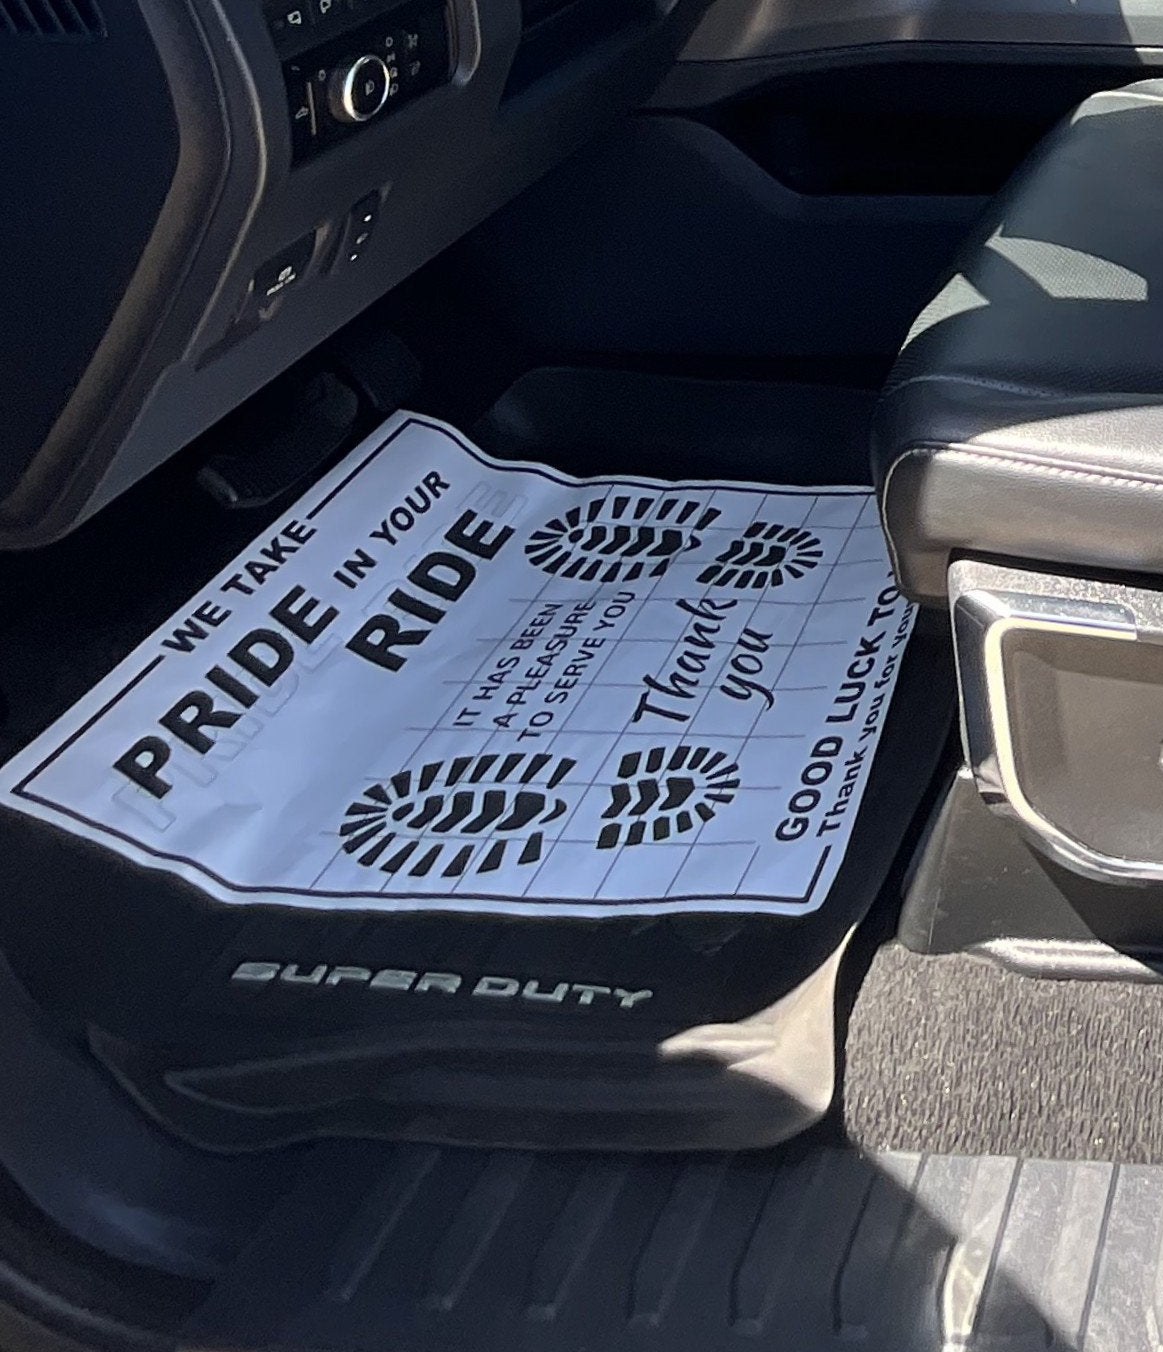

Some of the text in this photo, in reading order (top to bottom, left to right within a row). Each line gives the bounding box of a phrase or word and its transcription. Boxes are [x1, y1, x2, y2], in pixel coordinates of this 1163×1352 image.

[112, 471, 451, 799] PRIDE IN YOUR
[161, 519, 318, 653] WE TAKE
[345, 509, 516, 672] RIDE
[453, 603, 564, 726] IT HAS BEEN
[493, 601, 597, 728] A PLEASURE
[517, 591, 636, 742] TO SERVE YOU
[631, 598, 738, 723] Thank
[720, 628, 775, 711] you
[775, 585, 901, 841] GOOD LUCK TO
[816, 745, 867, 838] Thank
[859, 693, 886, 742] you
[874, 655, 899, 690] for
[231, 962, 654, 1008] SUPER DUTY
